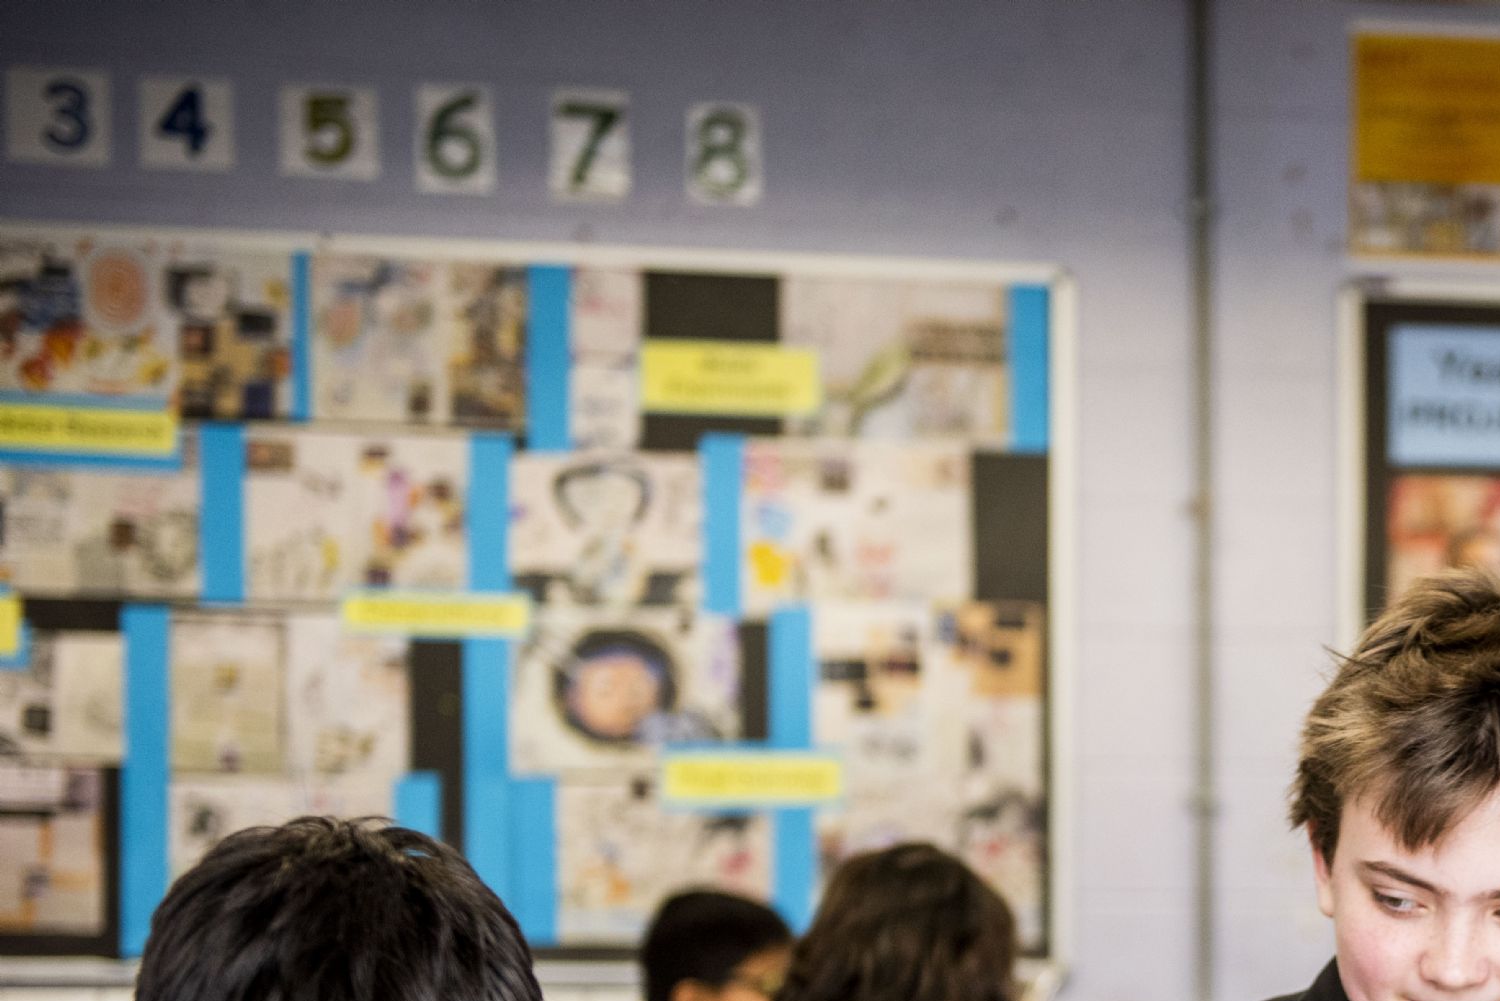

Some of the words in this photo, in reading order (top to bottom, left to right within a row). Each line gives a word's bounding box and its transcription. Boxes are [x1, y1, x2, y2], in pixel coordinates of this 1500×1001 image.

[45, 78, 89, 149] 3
[157, 82, 212, 155] 4
[303, 96, 357, 167] 5
[425, 96, 482, 180] 6
[555, 102, 624, 188] 7
[696, 107, 749, 197] 8
